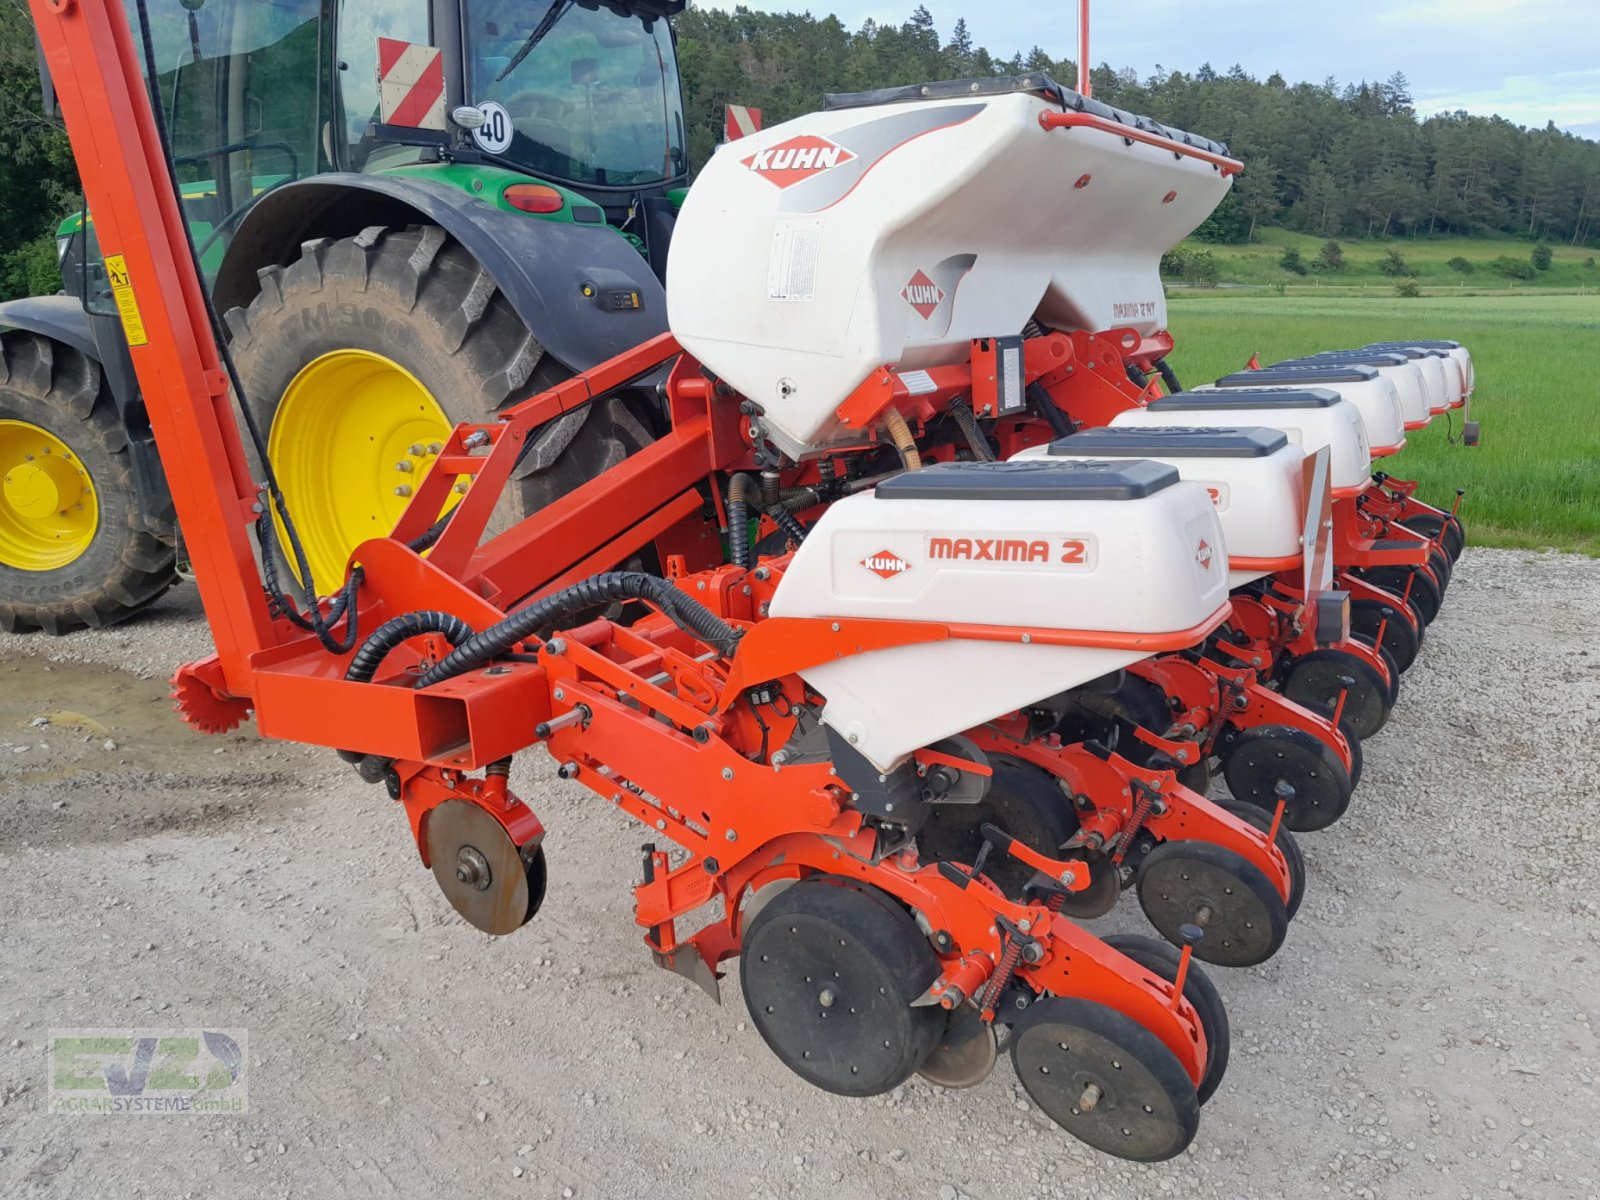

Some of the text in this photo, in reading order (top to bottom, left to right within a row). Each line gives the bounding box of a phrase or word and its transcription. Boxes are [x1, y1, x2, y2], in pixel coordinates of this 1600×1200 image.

[480, 109, 505, 143] 40
[749, 146, 842, 171] KUHN
[905, 285, 940, 304] KUHN
[864, 537, 1085, 572] KUHN MAXIMA 2
